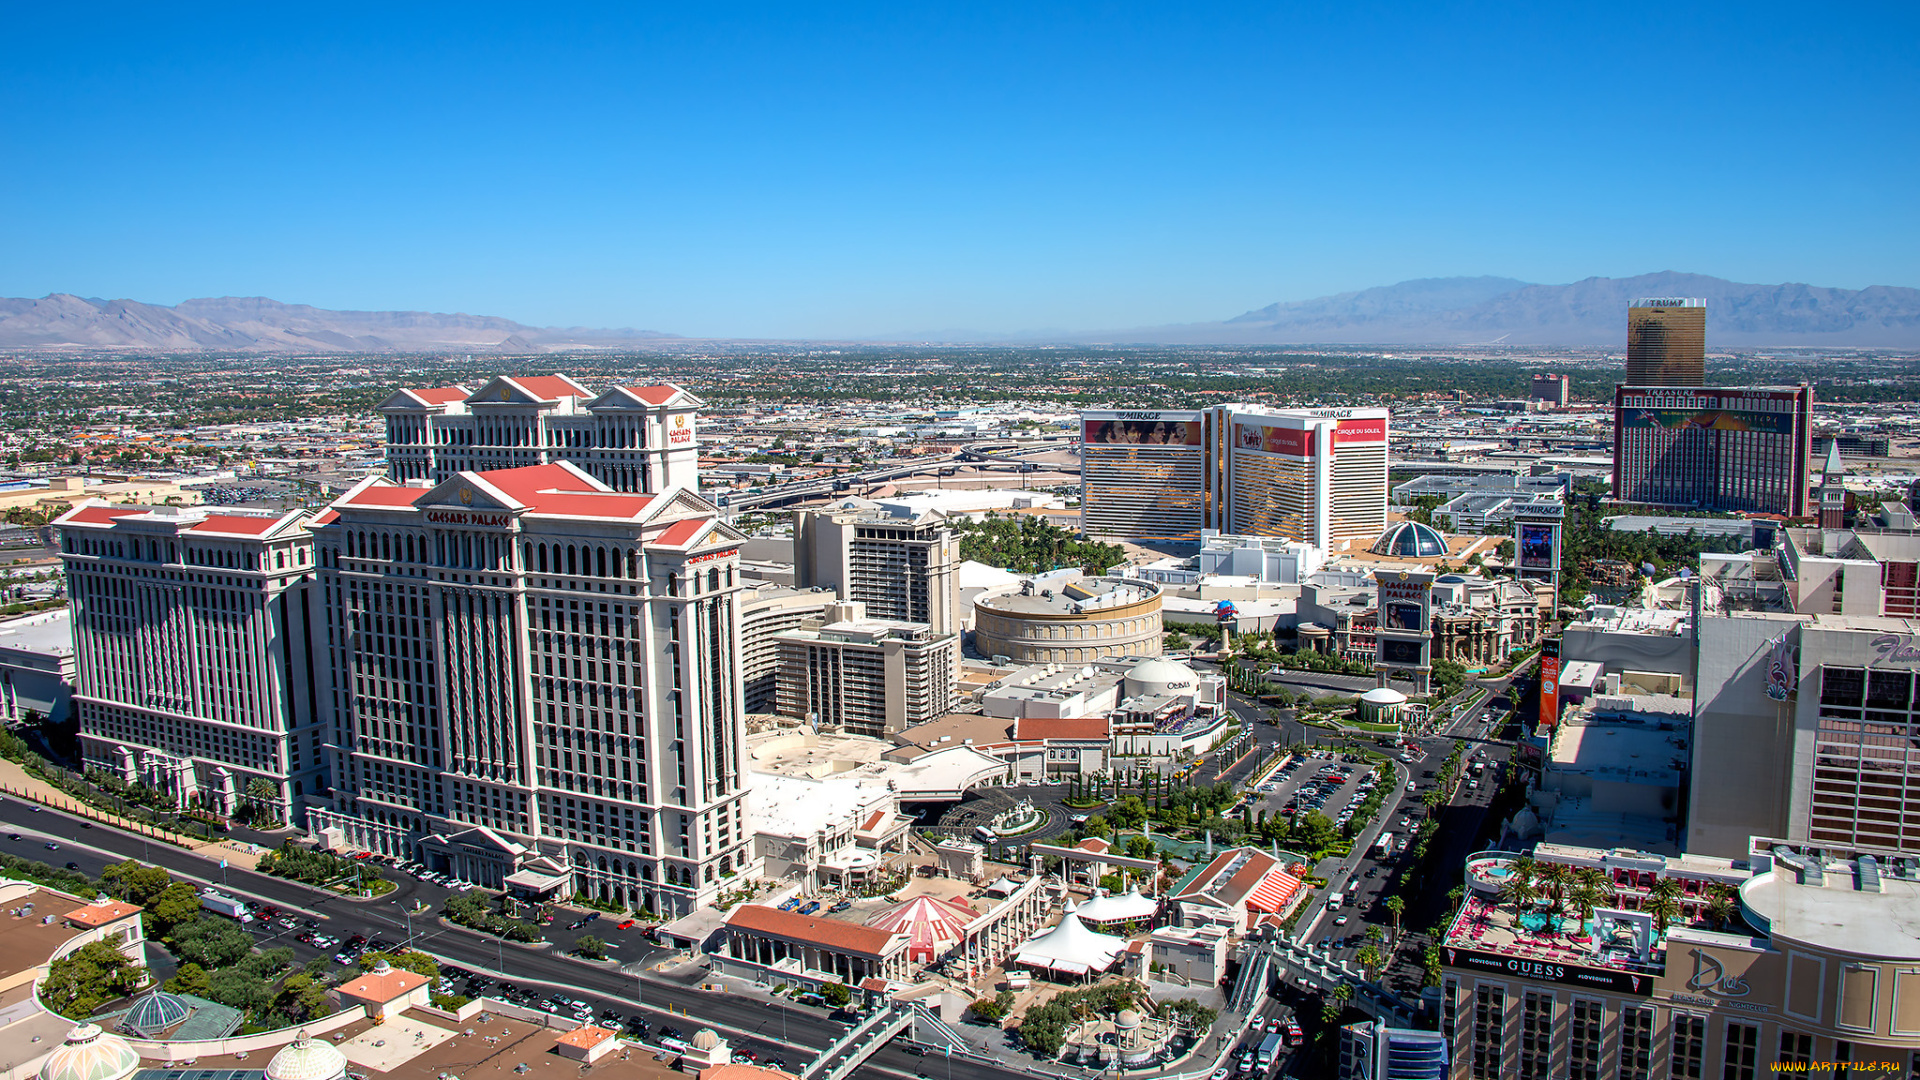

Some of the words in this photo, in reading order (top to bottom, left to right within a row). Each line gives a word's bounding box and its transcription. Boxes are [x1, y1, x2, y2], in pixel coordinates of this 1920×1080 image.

[1742, 391, 1771, 399] ISLAND
[1121, 412, 1160, 420] MIRAGE
[1318, 410, 1352, 418] MIRAGE
[670, 428, 691, 436] CAESARS
[1520, 506, 1562, 514] MIRAGE
[427, 512, 468, 524] CAESARS
[472, 514, 508, 526] PALACE
[1385, 582, 1423, 590] CAESARS
[1386, 590, 1422, 599] PALACE
[1508, 960, 1564, 977] GUESS
[1674, 994, 1696, 1002] BEACH
[1728, 1002, 1768, 1012] NIGHTCLUB
